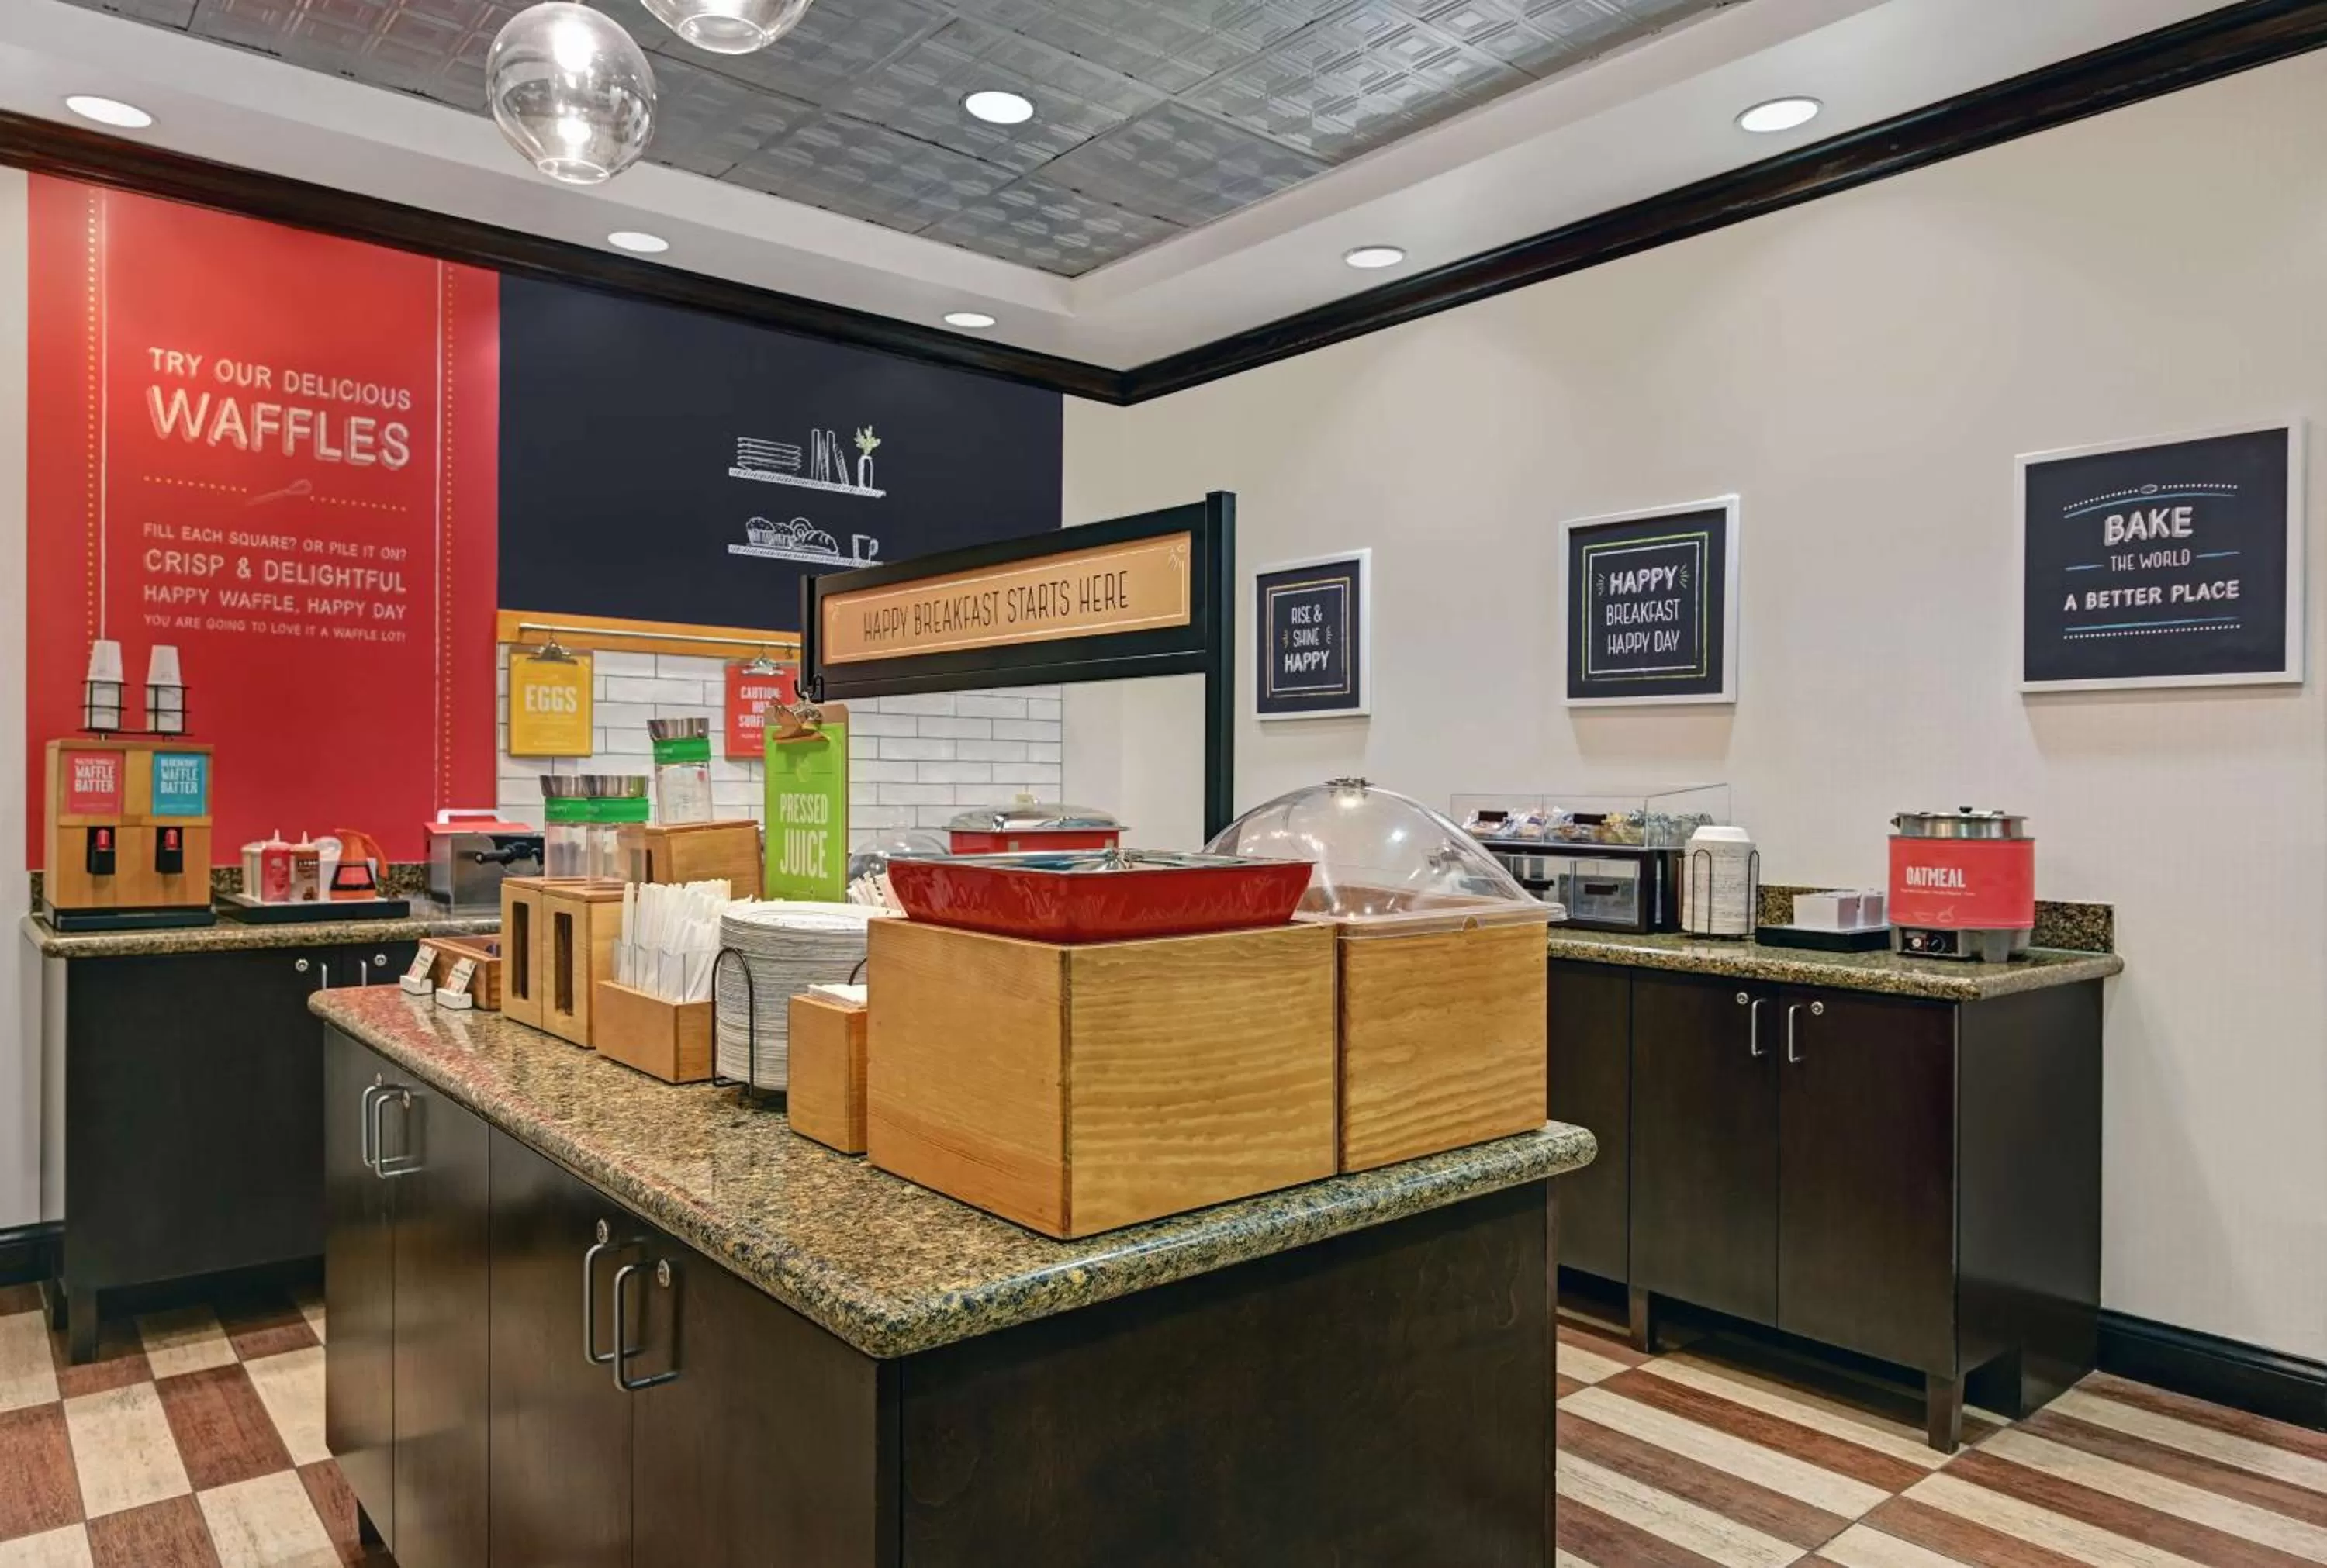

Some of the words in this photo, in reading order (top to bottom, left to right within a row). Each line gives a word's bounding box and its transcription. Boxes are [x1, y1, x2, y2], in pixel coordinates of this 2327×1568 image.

[149, 347, 203, 377] TRY
[214, 359, 271, 389] OUR
[283, 370, 411, 410] DELICIOUS
[147, 385, 410, 471] WAFFLES
[2104, 506, 2194, 546] BAKE
[143, 522, 174, 539] FILL
[181, 526, 223, 542] EACH
[229, 531, 297, 550] SQUARE?
[303, 540, 323, 554] OR
[330, 542, 358, 557] PILE
[363, 546, 374, 558] IT
[380, 547, 407, 560] ON?
[145, 549, 224, 577] CRISP
[237, 556, 251, 579] &
[264, 559, 406, 592] DELIGHTFUL
[2110, 554, 2135, 572] THE
[2139, 548, 2190, 569] WORLD
[1610, 565, 1678, 596] HAPPY
[143, 585, 209, 605] HAPPY
[219, 590, 300, 614] WAFFLE,
[308, 598, 366, 618] HAPPY
[372, 603, 406, 620] DAY
[863, 605, 908, 642] HAPPY
[915, 590, 1000, 636] BREAKFAST
[1008, 580, 1070, 623] STARTS
[1079, 570, 1129, 614] HERE
[2063, 593, 2078, 611] A
[2085, 587, 2162, 610] BETTER
[2170, 579, 2240, 603] PLACE
[1291, 606, 1312, 624] RISE
[1313, 604, 1323, 623] &
[1606, 598, 1681, 626] BREAKFAST
[144, 614, 170, 627] YOU
[175, 616, 199, 629] ARE
[206, 617, 245, 632] GOING
[251, 621, 266, 634] TO
[271, 623, 301, 636] LOVE
[306, 626, 316, 637] IT
[320, 627, 329, 638] A
[333, 628, 376, 641] WAFFLE
[1293, 627, 1320, 648] SHINE
[1607, 632, 1650, 655] HAPPY
[1654, 629, 1680, 652] DAY
[1285, 650, 1330, 673] HAPPY
[525, 685, 577, 713] EGGS
[74, 765, 115, 779] WAFFLE
[74, 779, 114, 793] BATTER
[161, 767, 199, 781] WAFFLE
[161, 781, 198, 794] BATTER
[780, 793, 828, 824] PRESSED
[780, 828, 828, 879] JUICE
[1906, 866, 1966, 888] OATMEAL
